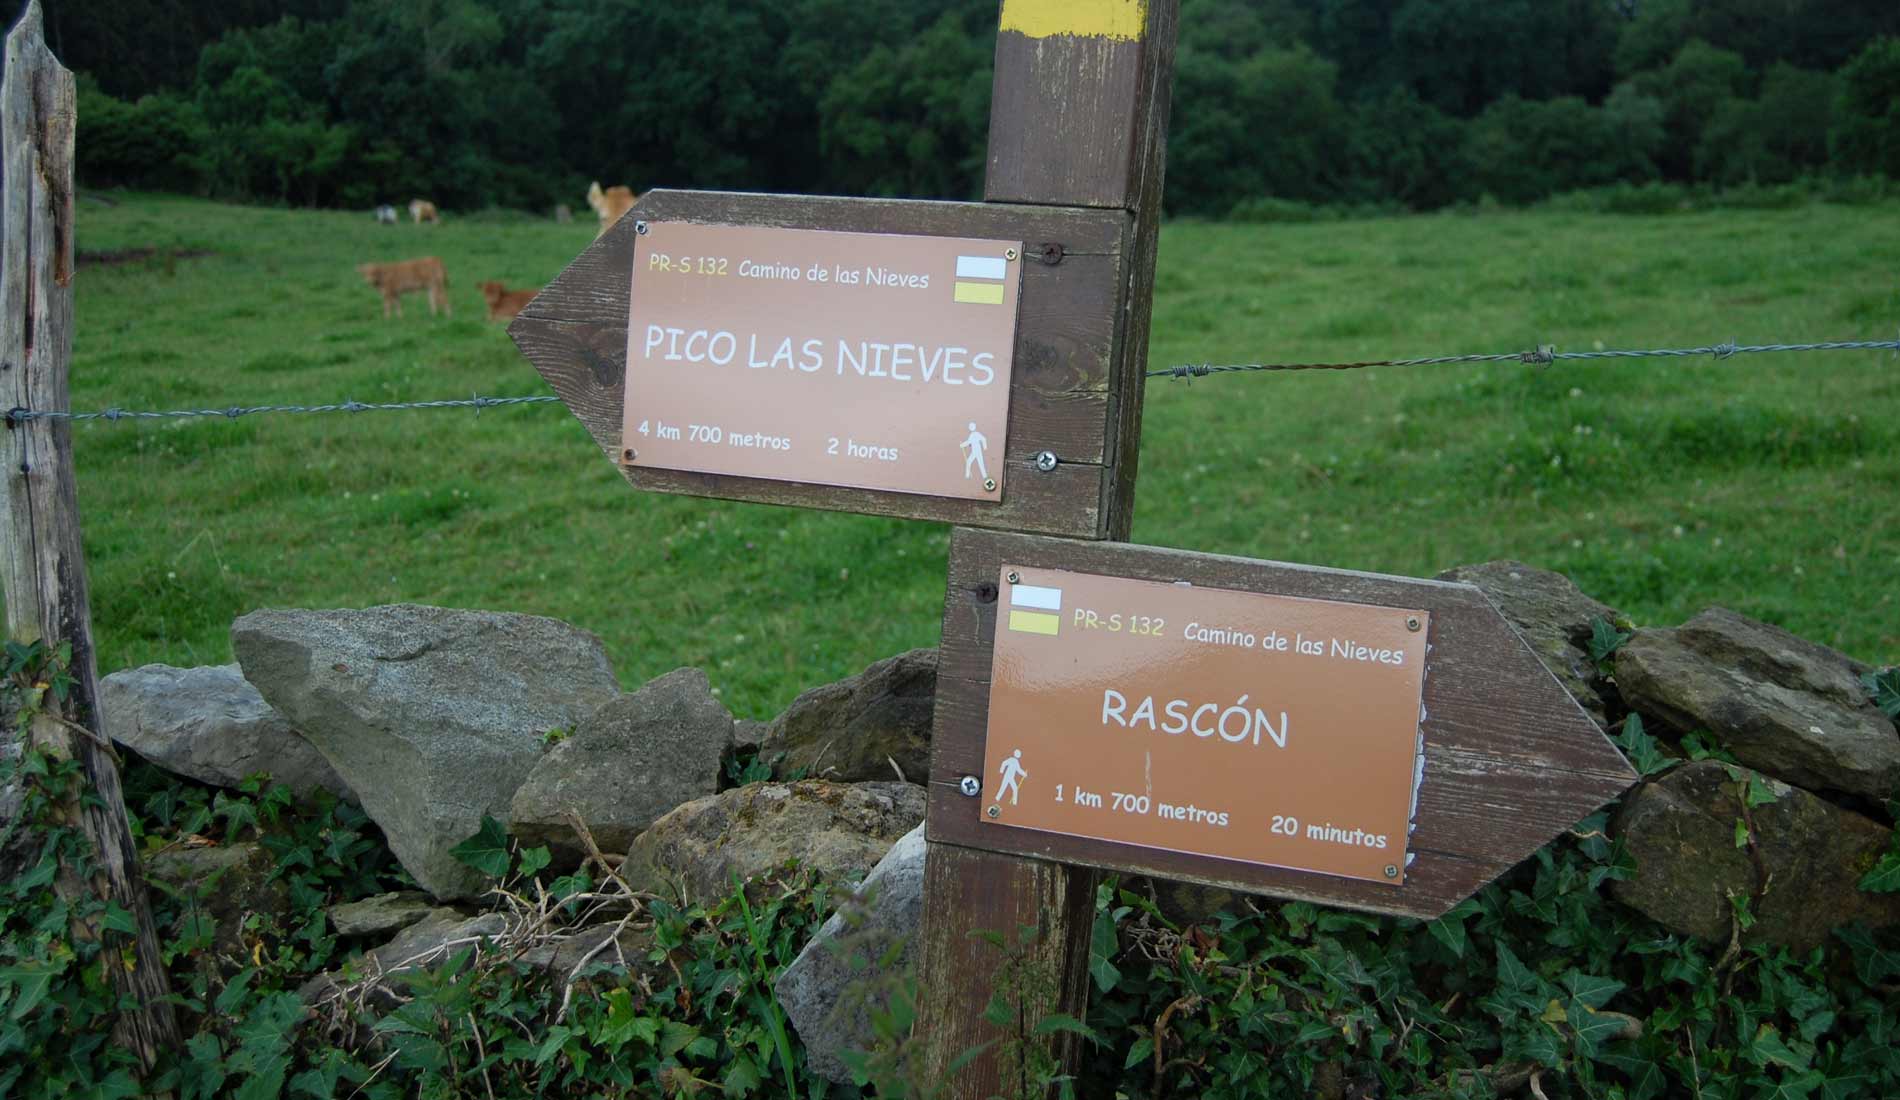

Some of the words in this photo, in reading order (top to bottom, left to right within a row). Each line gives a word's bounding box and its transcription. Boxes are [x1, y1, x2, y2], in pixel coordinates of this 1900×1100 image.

[649, 252, 691, 274] PR-S
[697, 252, 728, 276] 132
[738, 259, 801, 281] Camino
[806, 263, 829, 282] de
[834, 264, 860, 285] las
[865, 266, 930, 289] Nieves
[645, 324, 737, 366] PICO
[748, 333, 823, 372] LAS
[837, 339, 995, 387] NIEVES
[638, 420, 650, 437] 4
[656, 420, 681, 442] km
[688, 424, 722, 444] 700
[729, 431, 791, 451] metros
[827, 437, 840, 456] 2
[847, 439, 899, 462] horas
[1073, 608, 1122, 633] PR-S
[1129, 615, 1165, 637] 132
[1183, 622, 1256, 648] Camino
[1262, 630, 1288, 652] de
[1295, 633, 1324, 656] las
[1330, 637, 1404, 666] Nieves
[1101, 689, 1288, 748] RASCÓN
[1054, 783, 1064, 802] 1
[1074, 785, 1102, 809] km
[1111, 791, 1151, 815] 700
[1157, 801, 1229, 827] metros
[1270, 814, 1299, 836] 20
[1306, 821, 1387, 850] minutos
